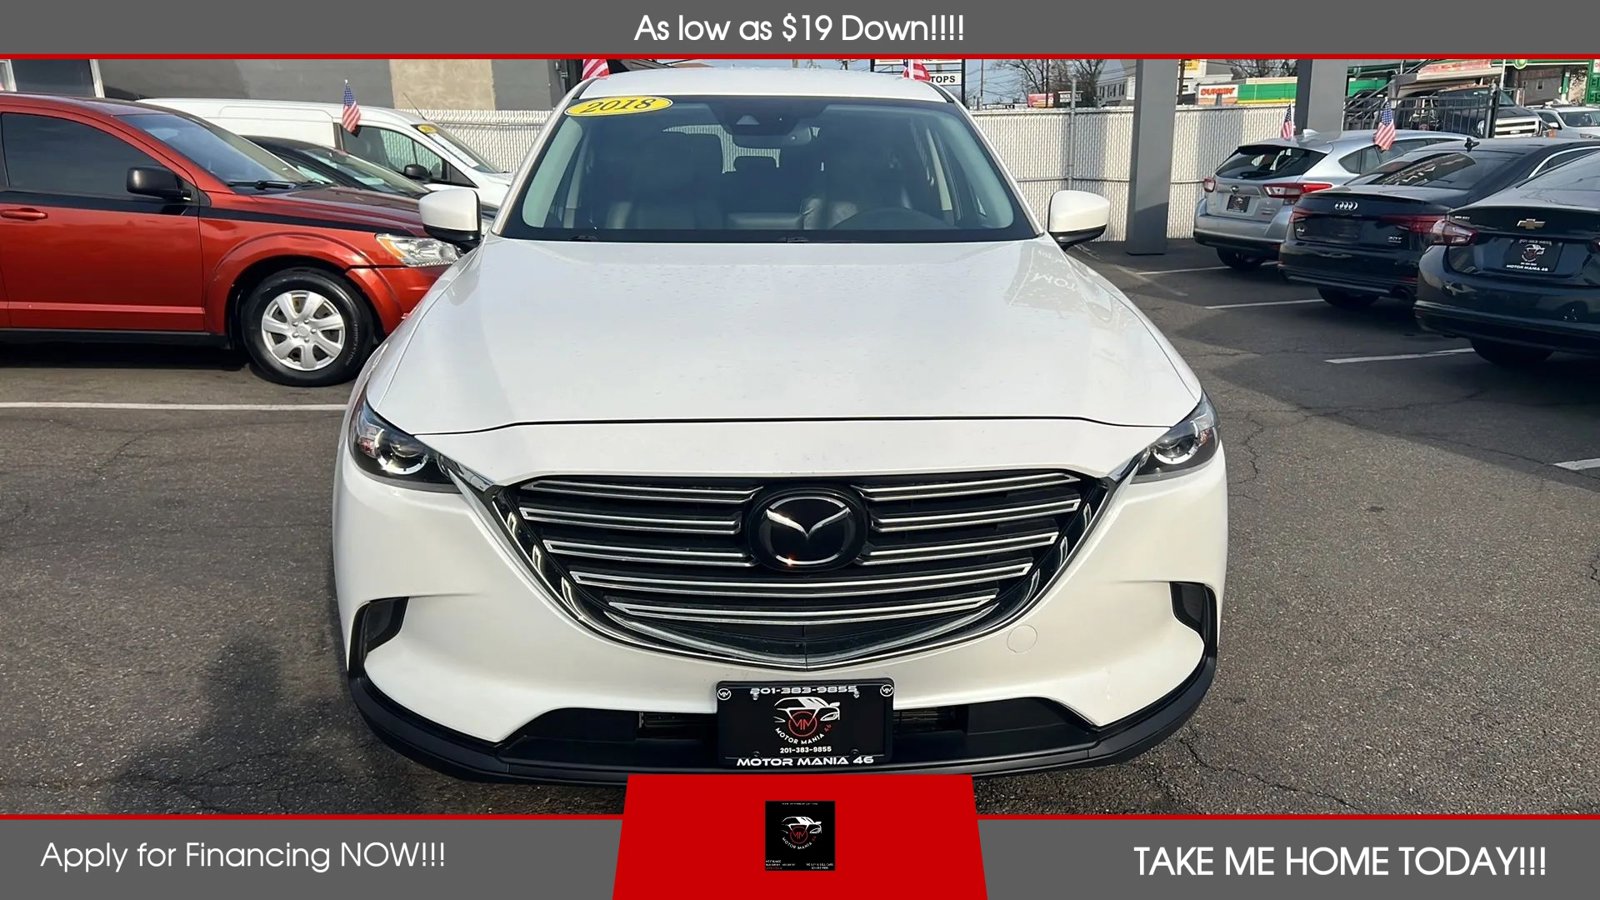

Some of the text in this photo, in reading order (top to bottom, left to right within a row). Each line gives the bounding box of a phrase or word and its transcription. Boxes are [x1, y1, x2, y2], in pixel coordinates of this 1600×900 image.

[580, 98, 657, 114] 2018
[750, 685, 859, 695] 201-383-9855
[775, 727, 799, 745] MOTOR
[800, 733, 825, 745] MANIA
[779, 746, 832, 754] 201-383-9855
[736, 755, 875, 767] MOTOR MANIA 46
